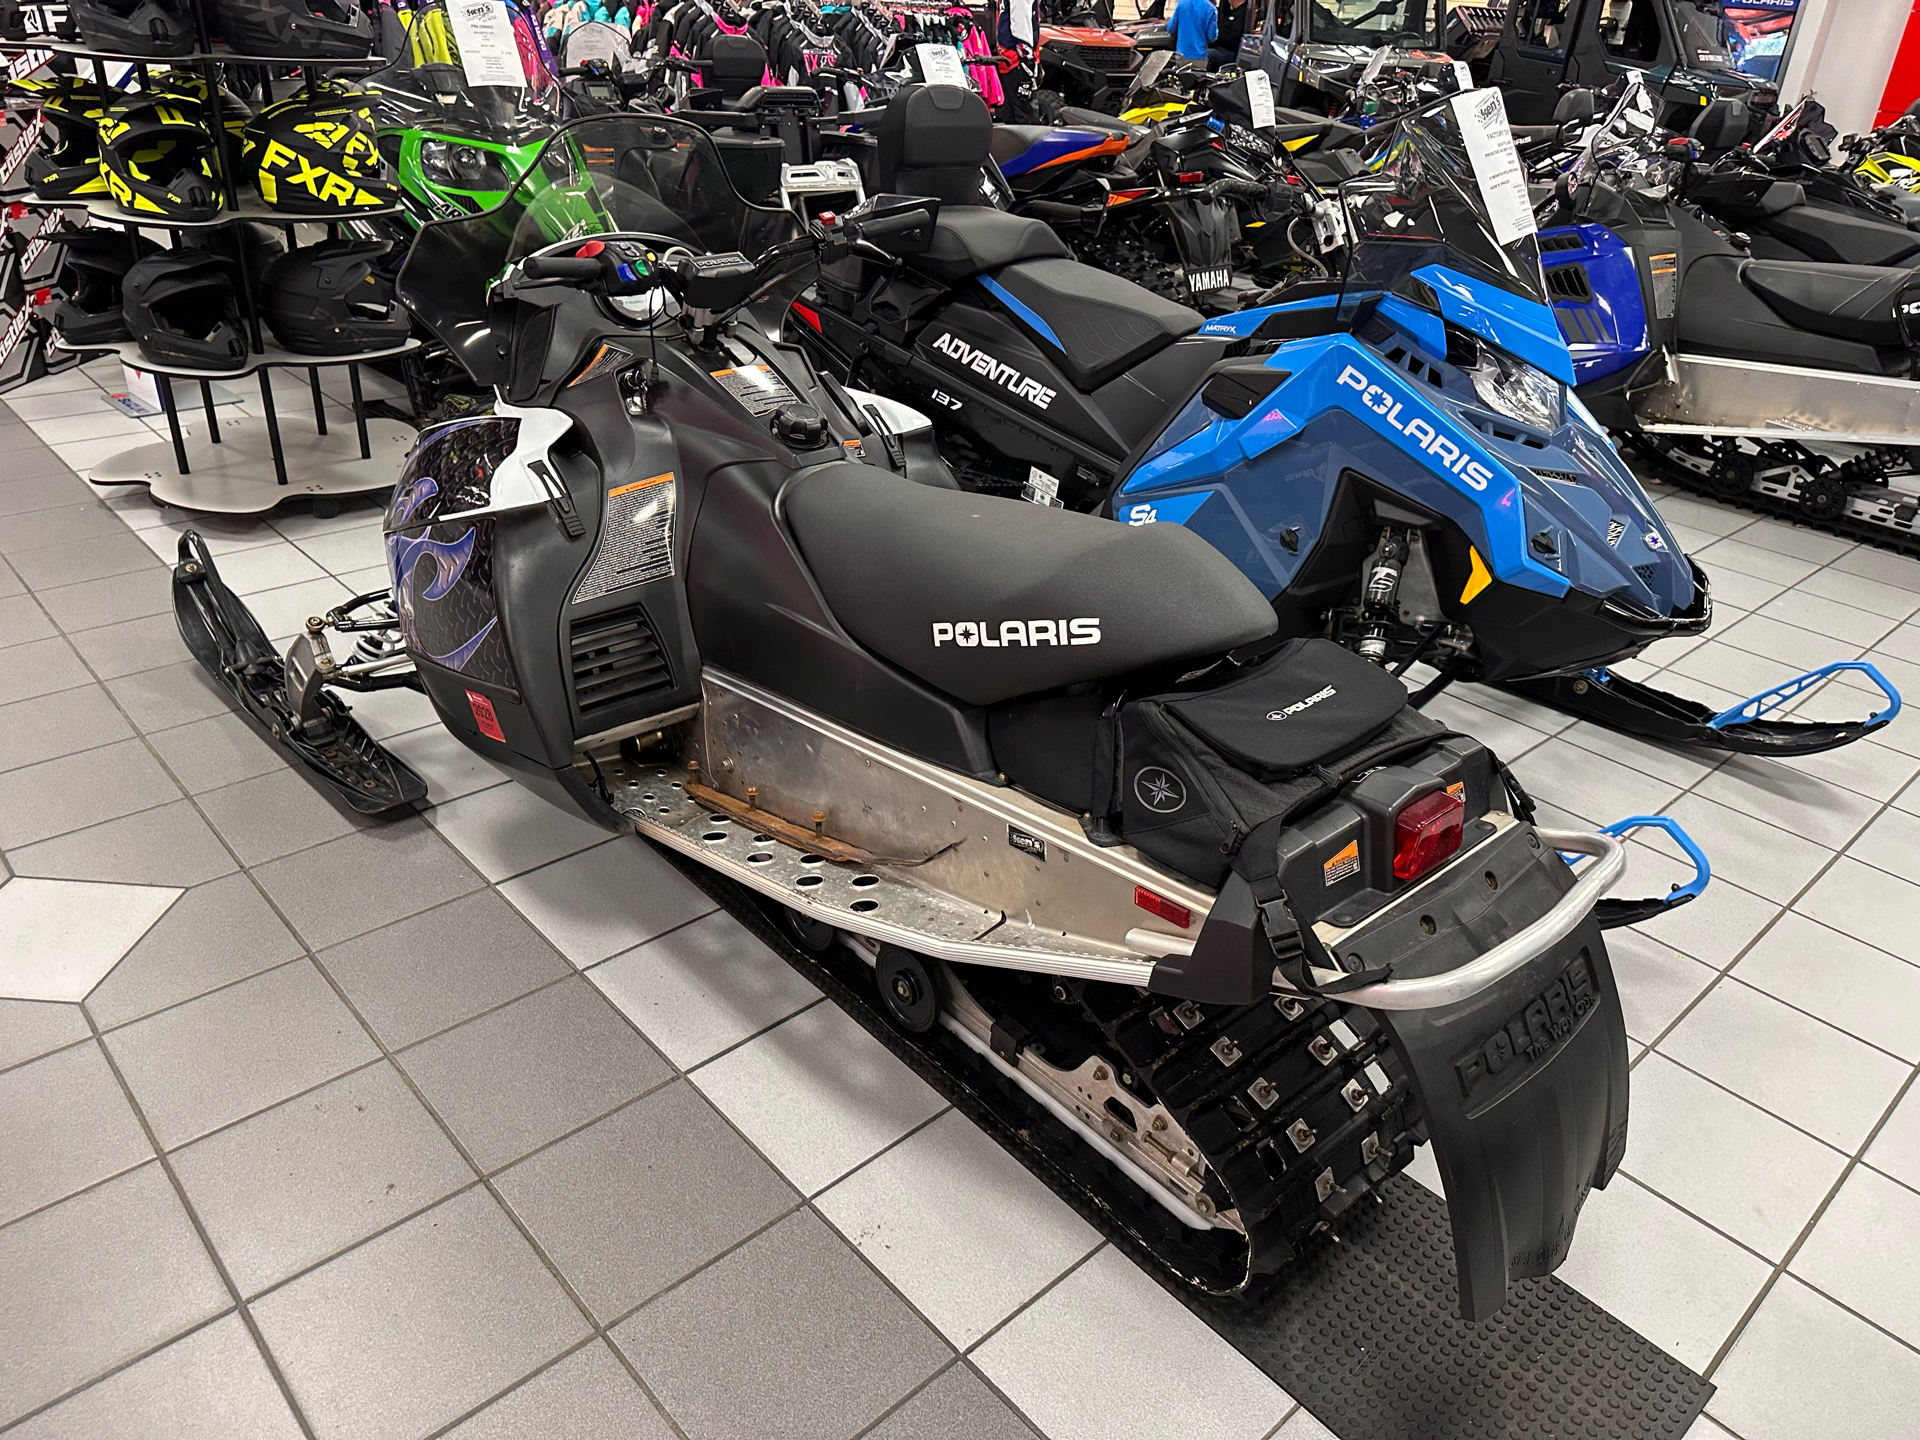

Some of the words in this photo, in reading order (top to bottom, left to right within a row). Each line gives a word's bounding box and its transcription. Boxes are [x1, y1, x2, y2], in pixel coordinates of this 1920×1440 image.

[43, 173, 59, 184] FXR
[258, 139, 356, 207] FXR
[167, 192, 182, 204] FXR
[696, 256, 742, 268] POLARIS
[1188, 268, 1230, 293] YAMAHA
[1204, 324, 1237, 334] MATRYX
[932, 332, 1058, 411] ADVENTURE
[931, 388, 964, 411] 137
[1335, 364, 1495, 492] POLARIS
[1128, 503, 1159, 527] S4
[932, 617, 1102, 648] POLARIS
[1282, 684, 1338, 715] POLARIS
[1454, 958, 1596, 1098] POLARIS
[1524, 1038, 1550, 1062] The
[1549, 1013, 1575, 1042] Way
